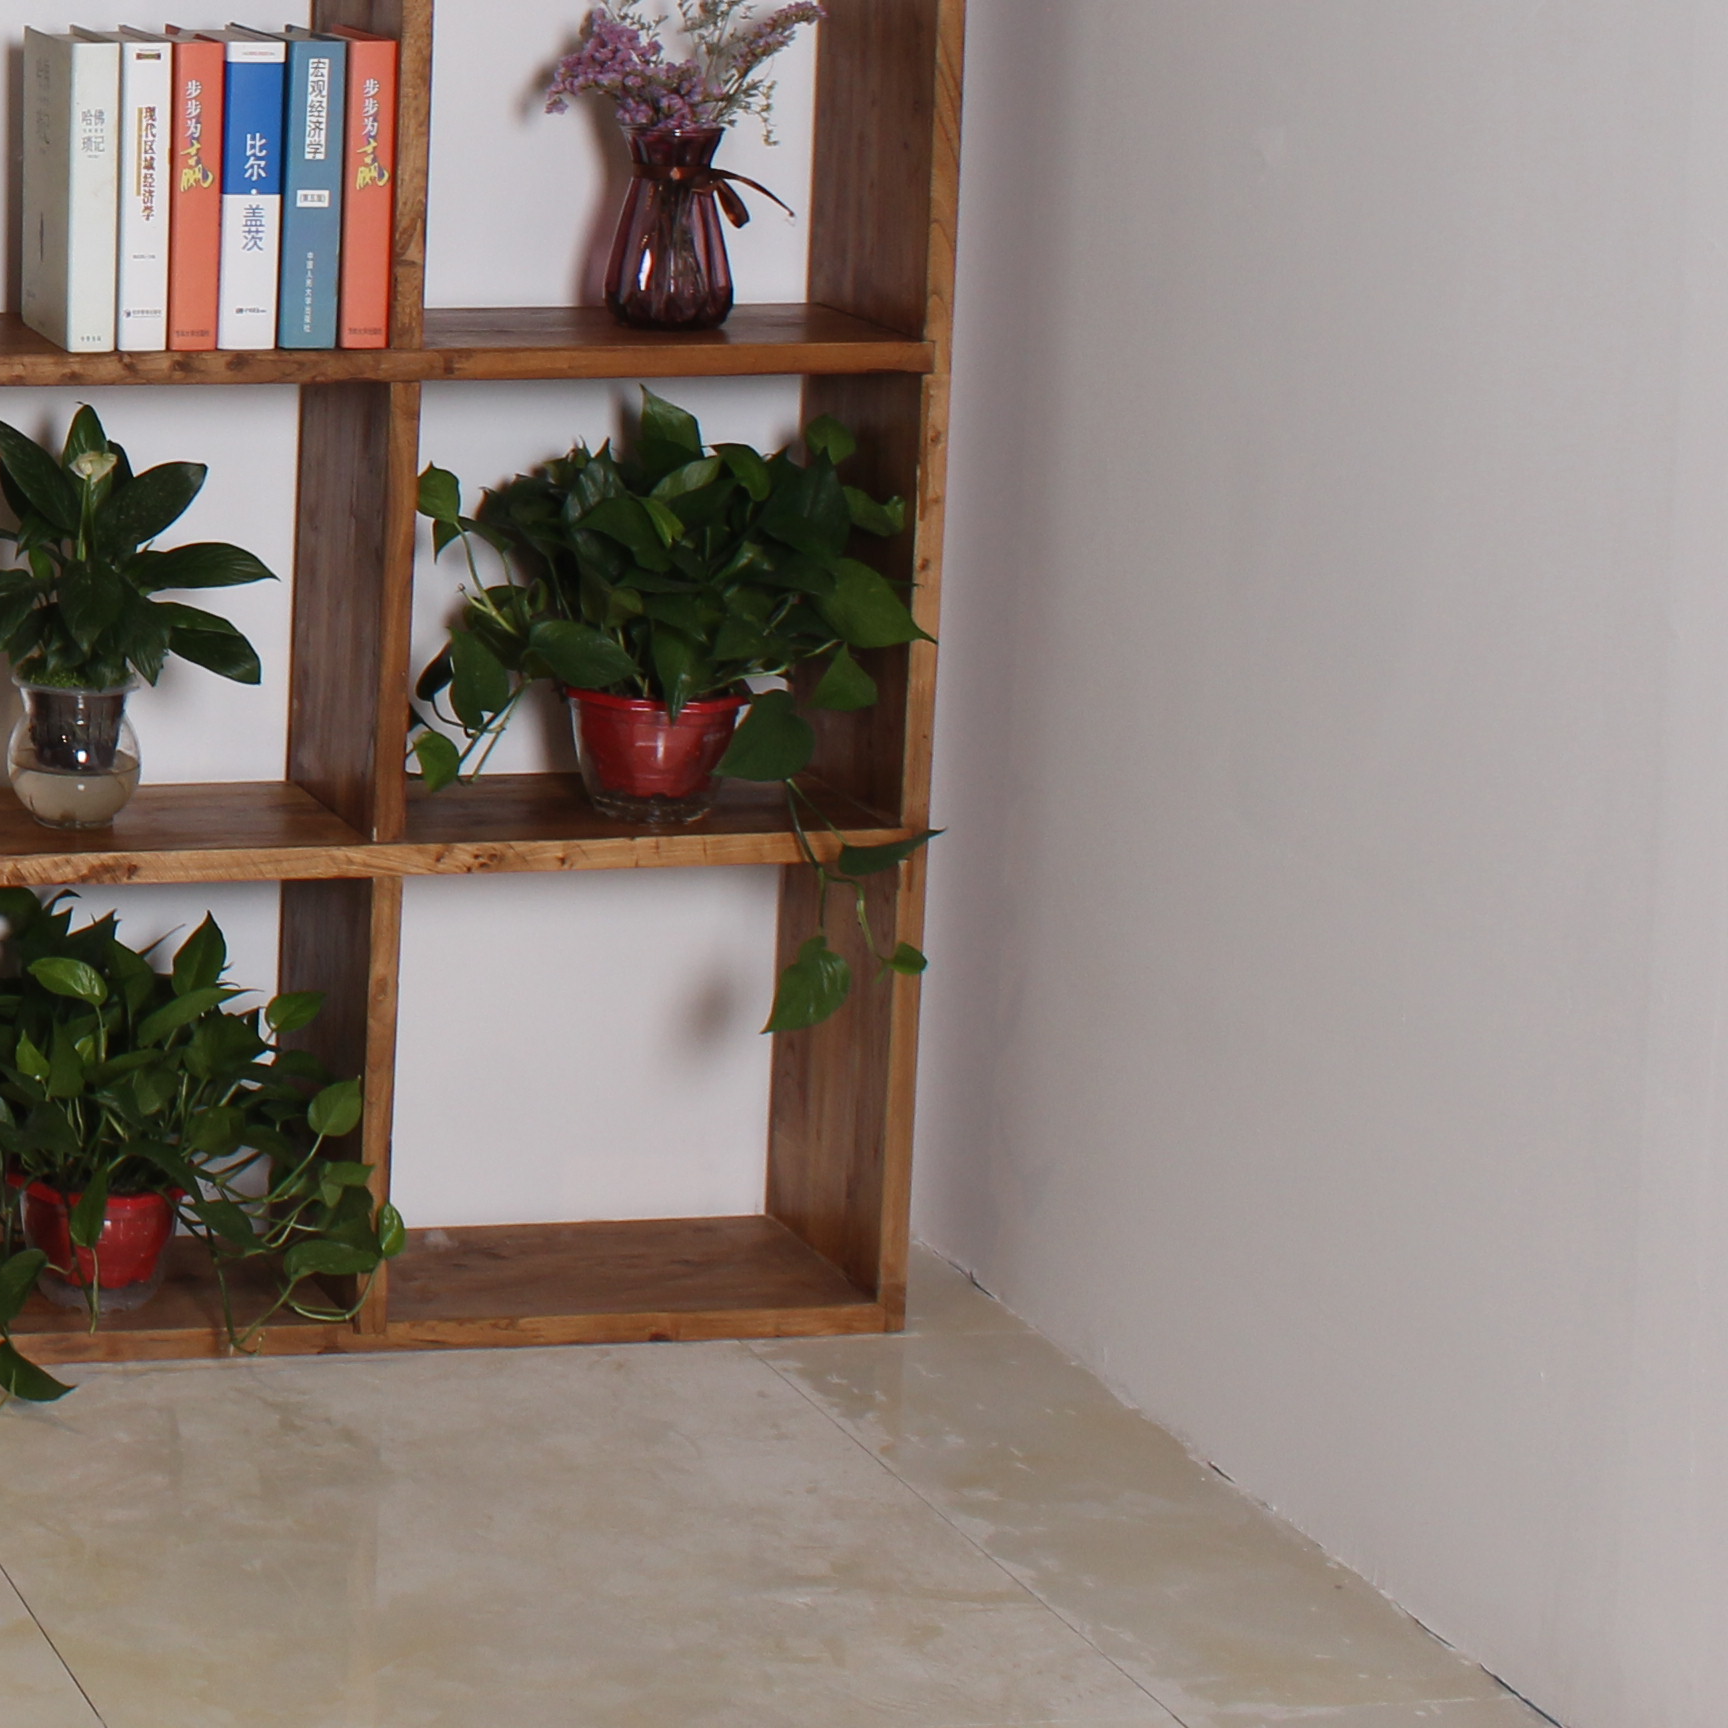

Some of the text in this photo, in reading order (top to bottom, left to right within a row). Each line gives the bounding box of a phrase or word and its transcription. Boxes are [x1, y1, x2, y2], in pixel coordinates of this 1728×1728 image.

[81, 109, 106, 127] 哈佛
[81, 135, 106, 153] 琐记
[306, 58, 329, 160] 宏观经济学
[141, 105, 157, 222] 现代区域经济学
[241, 132, 268, 252] 比尔·盖茨
